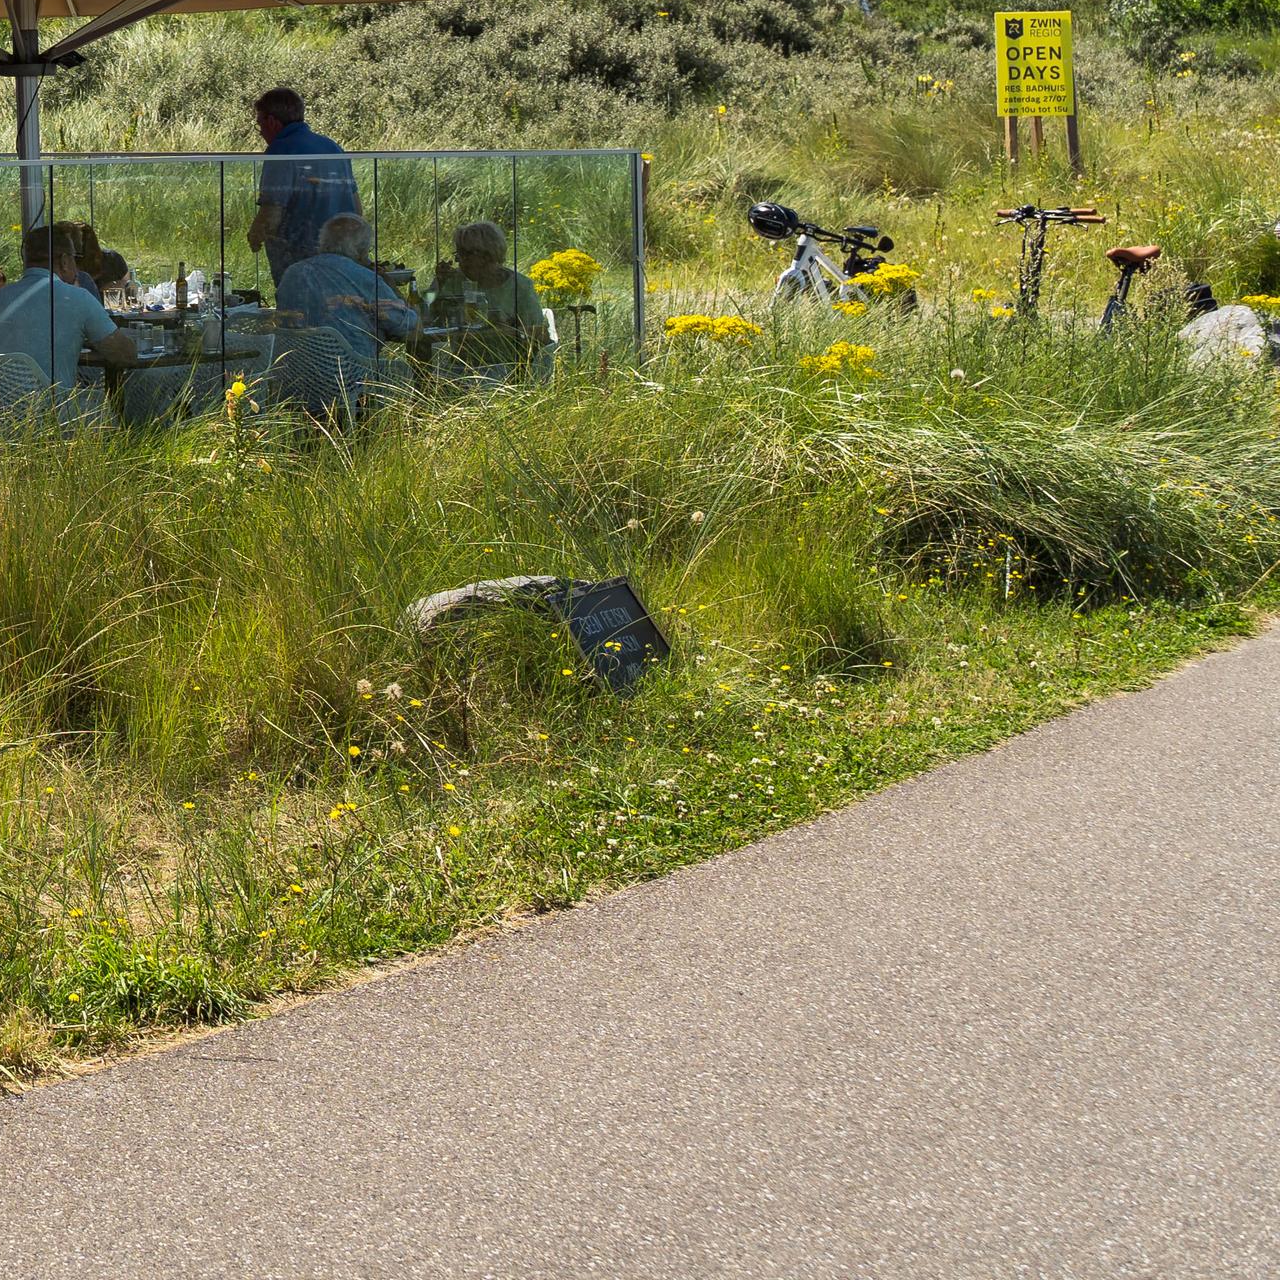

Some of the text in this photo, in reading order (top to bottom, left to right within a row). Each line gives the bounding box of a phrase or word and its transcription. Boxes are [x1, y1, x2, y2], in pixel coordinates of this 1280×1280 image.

[1030, 18, 1061, 28] ZWIN
[1030, 29, 1061, 37] REGIO
[1006, 47, 1061, 61] OPEN
[1008, 66, 1060, 80] DAYS
[1026, 84, 1065, 92] BADHUIS
[1004, 96, 1041, 104] zaterdag
